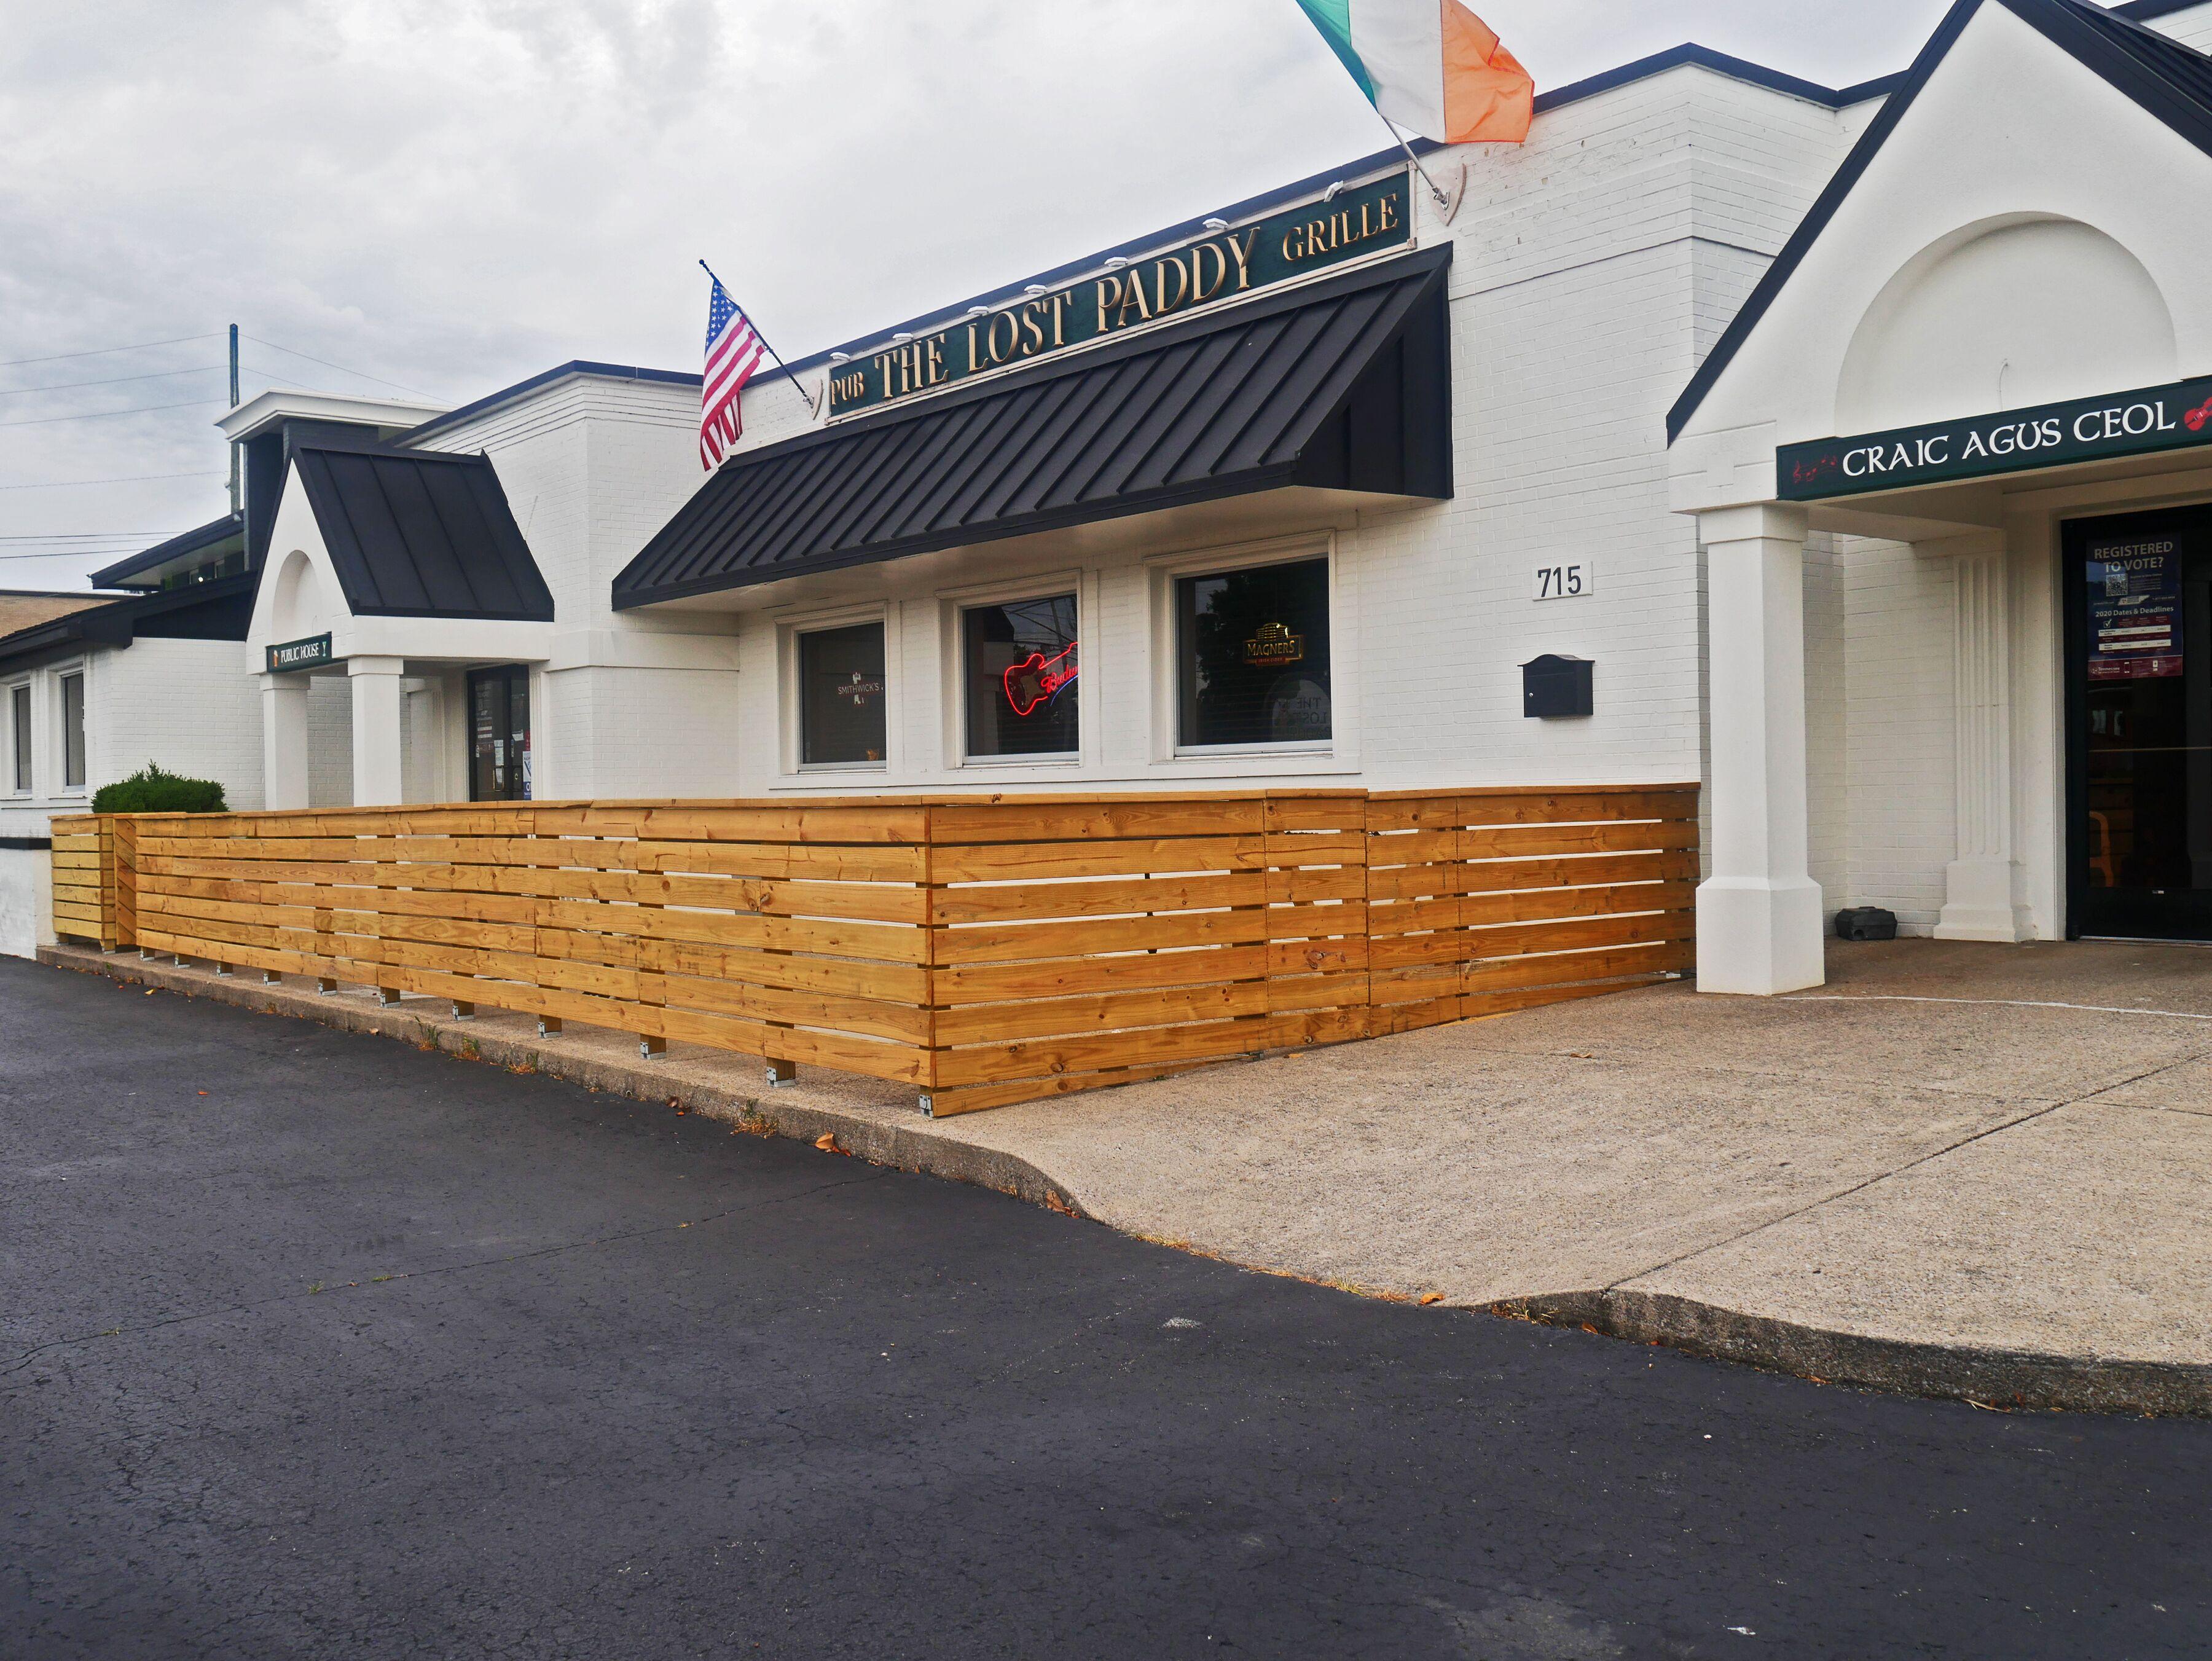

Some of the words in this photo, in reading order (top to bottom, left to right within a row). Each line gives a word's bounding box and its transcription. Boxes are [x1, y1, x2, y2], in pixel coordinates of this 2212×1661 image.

[831, 372, 865, 406] PUB
[874, 333, 949, 399] THE
[967, 291, 1072, 373] LOST
[1096, 227, 1260, 332] PADDY
[1283, 194, 1398, 261] GRILLE
[1843, 436, 1950, 477] CRAIC
[1962, 418, 2062, 460] AGUS
[2074, 401, 2176, 442] CEOL
[2094, 541, 2173, 559] REGISTERED
[2104, 561, 2122, 573] TO
[2124, 557, 2164, 571] VOTE?
[1537, 565, 1582, 597] 715
[281, 646, 299, 663] PUBLIC
[300, 643, 319, 659] HOUSE
[1247, 640, 1295, 656] MAGNERS
[837, 682, 879, 694] SMITHWICK'S
